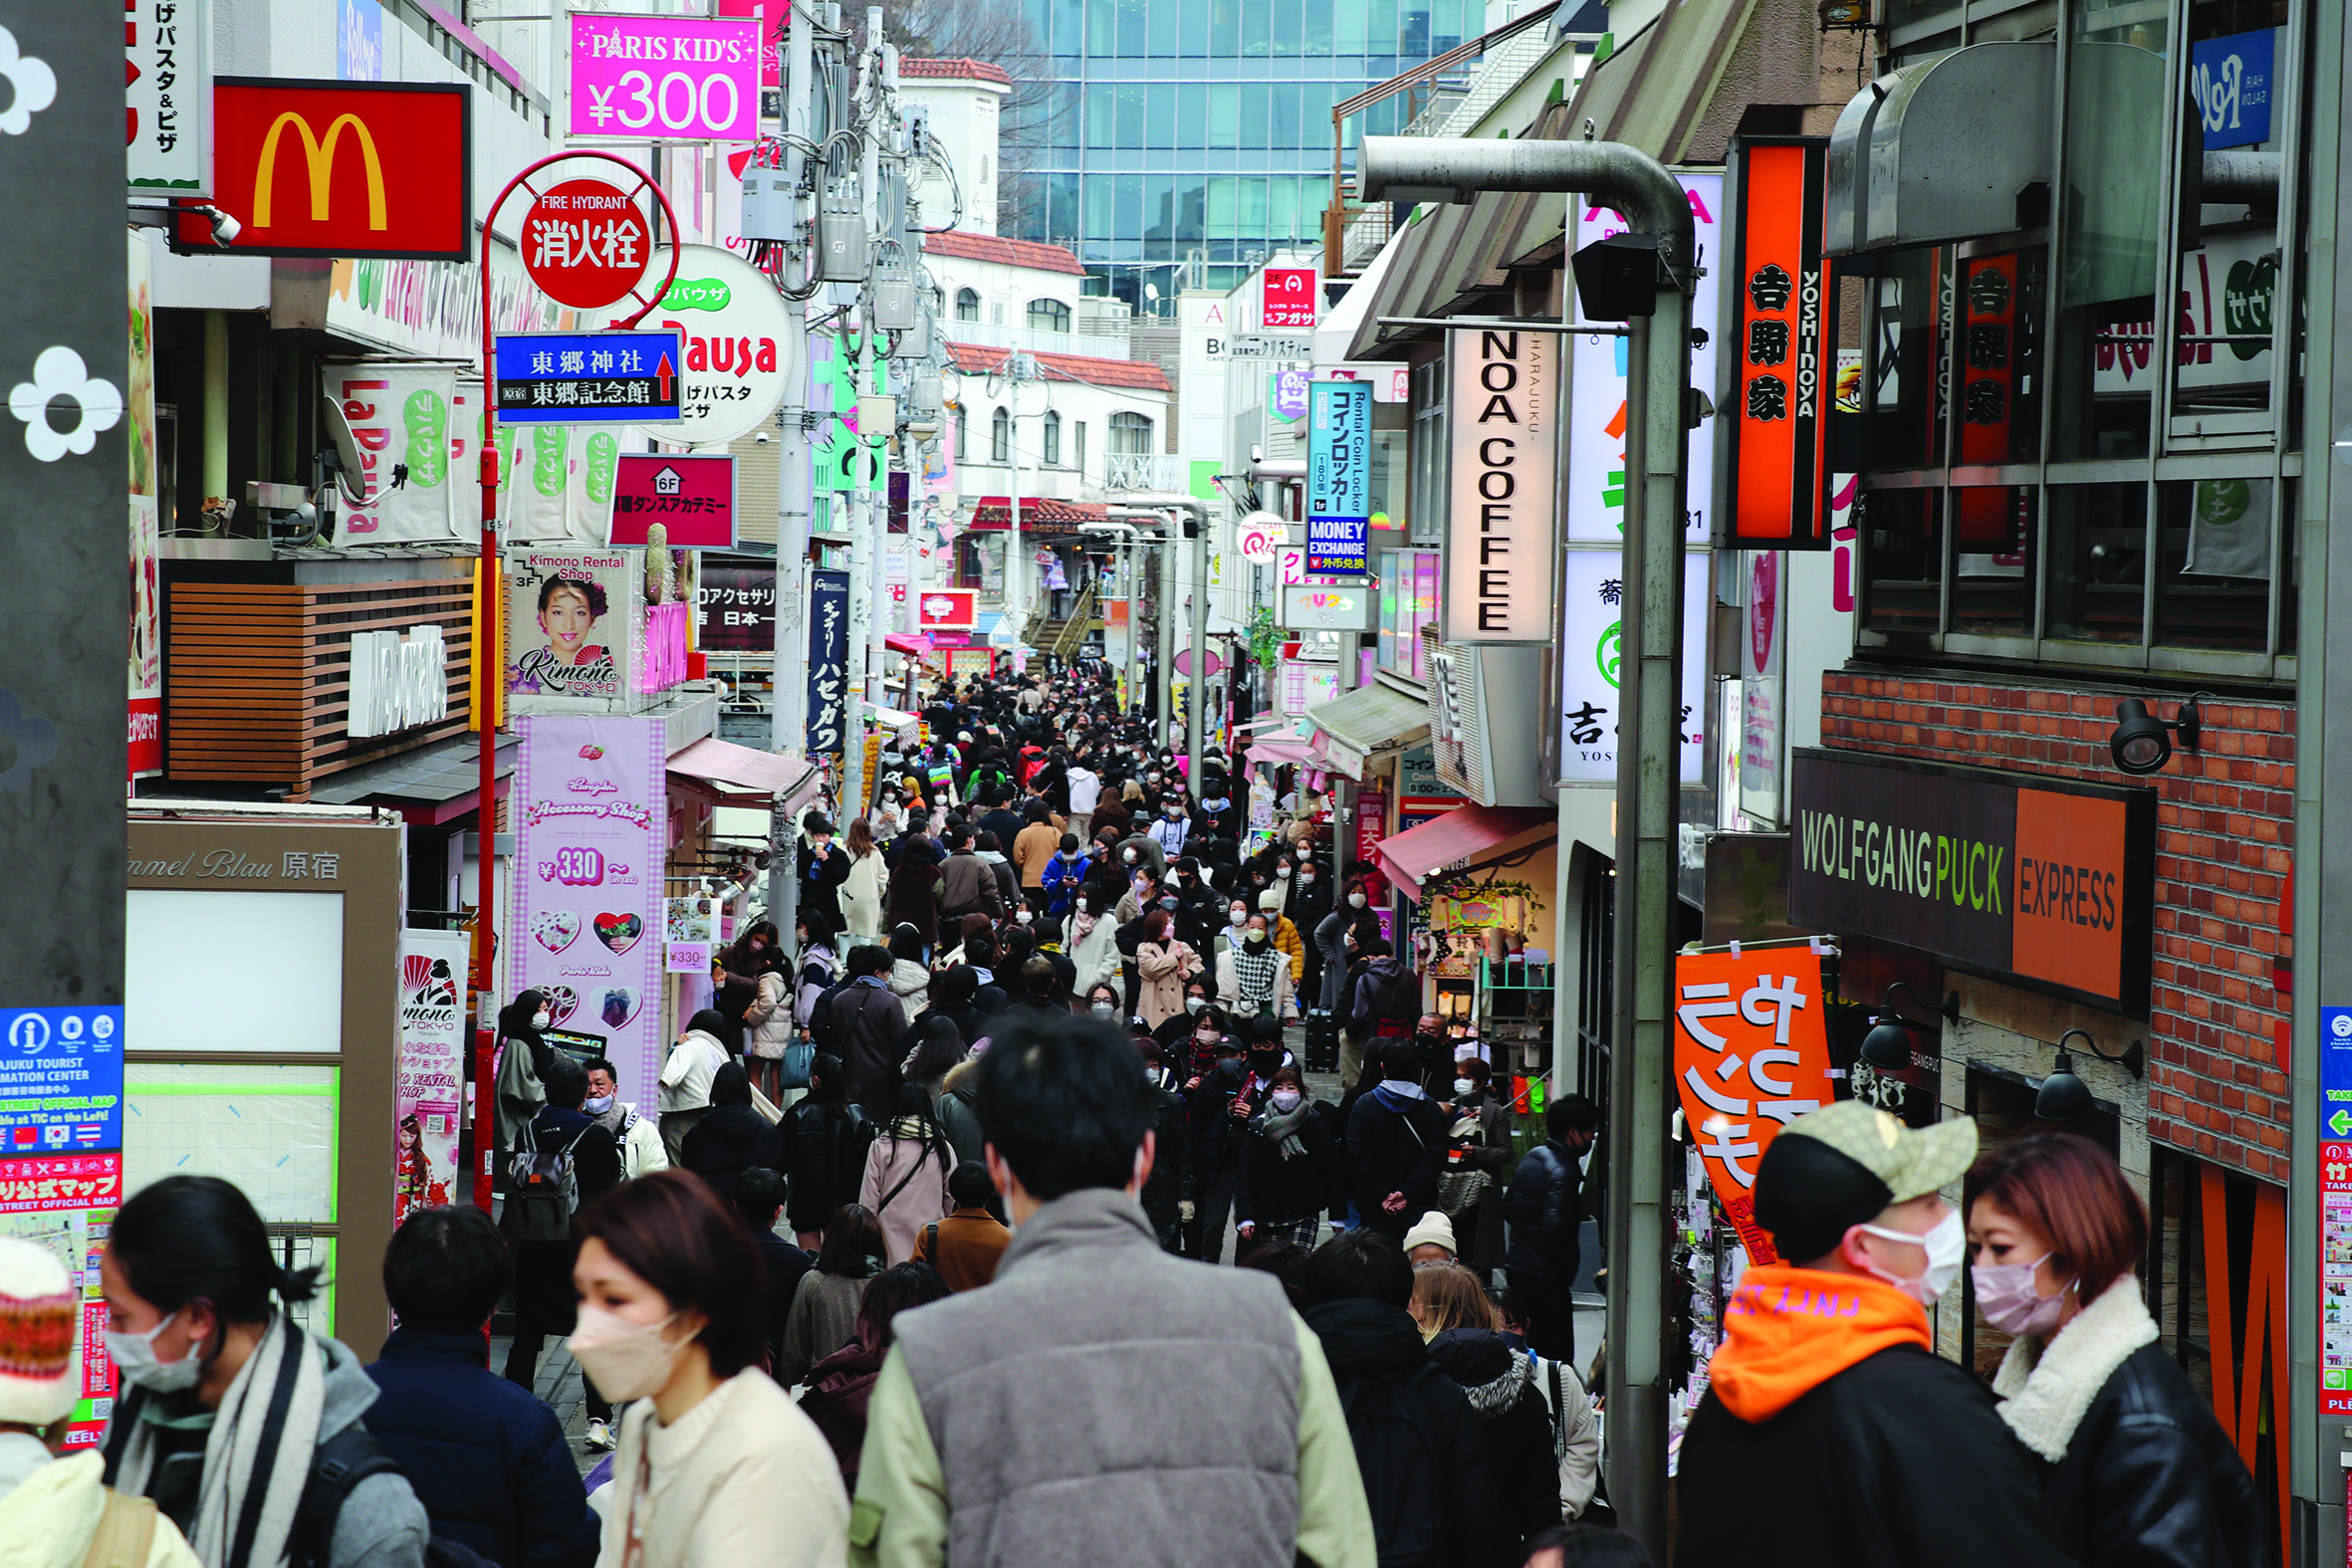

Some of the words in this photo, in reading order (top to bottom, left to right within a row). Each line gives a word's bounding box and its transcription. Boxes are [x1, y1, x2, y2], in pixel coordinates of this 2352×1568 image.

[591, 27, 667, 61] PARIS
[672, 37, 742, 64] KID'S
[588, 70, 739, 131] ¥300
[541, 196, 569, 210] FIRE
[572, 195, 628, 210] HYDRANT
[532, 219, 642, 269] 消火栓
[1275, 313, 1314, 325] アガサ
[1748, 264, 1793, 422] 吉野家
[530, 349, 644, 375] 東郷神社
[531, 380, 650, 405] 東郷記念館
[1354, 392, 1365, 433] Rental
[415, 393, 437, 485] ラパウザ
[1331, 392, 1350, 512] コインロッカー
[1353, 436, 1364, 465] Coin
[658, 478, 677, 490] 6F
[1351, 469, 1362, 514] Locker
[1310, 522, 1365, 540] MONEY
[1478, 436, 1518, 633] COFFEE
[1309, 543, 1365, 556] EXCHANGE
[529, 555, 580, 567] Kimono
[583, 556, 624, 567] Rental
[1322, 558, 1365, 568] 外币兑换
[516, 577, 536, 587] 3F
[559, 568, 593, 582] Shop
[519, 649, 617, 691] Kimono
[565, 681, 616, 693] TOKYO
[812, 663, 843, 752] ハセガワ
[1412, 773, 1434, 782] Coin
[534, 800, 609, 818] Accessory
[609, 800, 650, 823] Shop
[196, 849, 275, 879] Blau
[281, 850, 341, 880] 原宿
[2019, 856, 2116, 932] EXPRESS
[559, 965, 586, 977] Paris
[409, 1020, 454, 1030] TOKYO
[36, 1057, 84, 1069] TOURIST
[47, 1069, 90, 1081] CENTER
[414, 1074, 456, 1087] RENTAL
[0, 1098, 42, 1112] STREET
[43, 1097, 91, 1110] OFFICIAL
[92, 1095, 118, 1108] MAP
[31, 1112, 48, 1124] TIC
[65, 1112, 82, 1122] the
[84, 1110, 109, 1122] Left!
[0, 1200, 39, 1211] STREET
[42, 1198, 91, 1209] OFFICIAL
[93, 1197, 118, 1207] MAP
